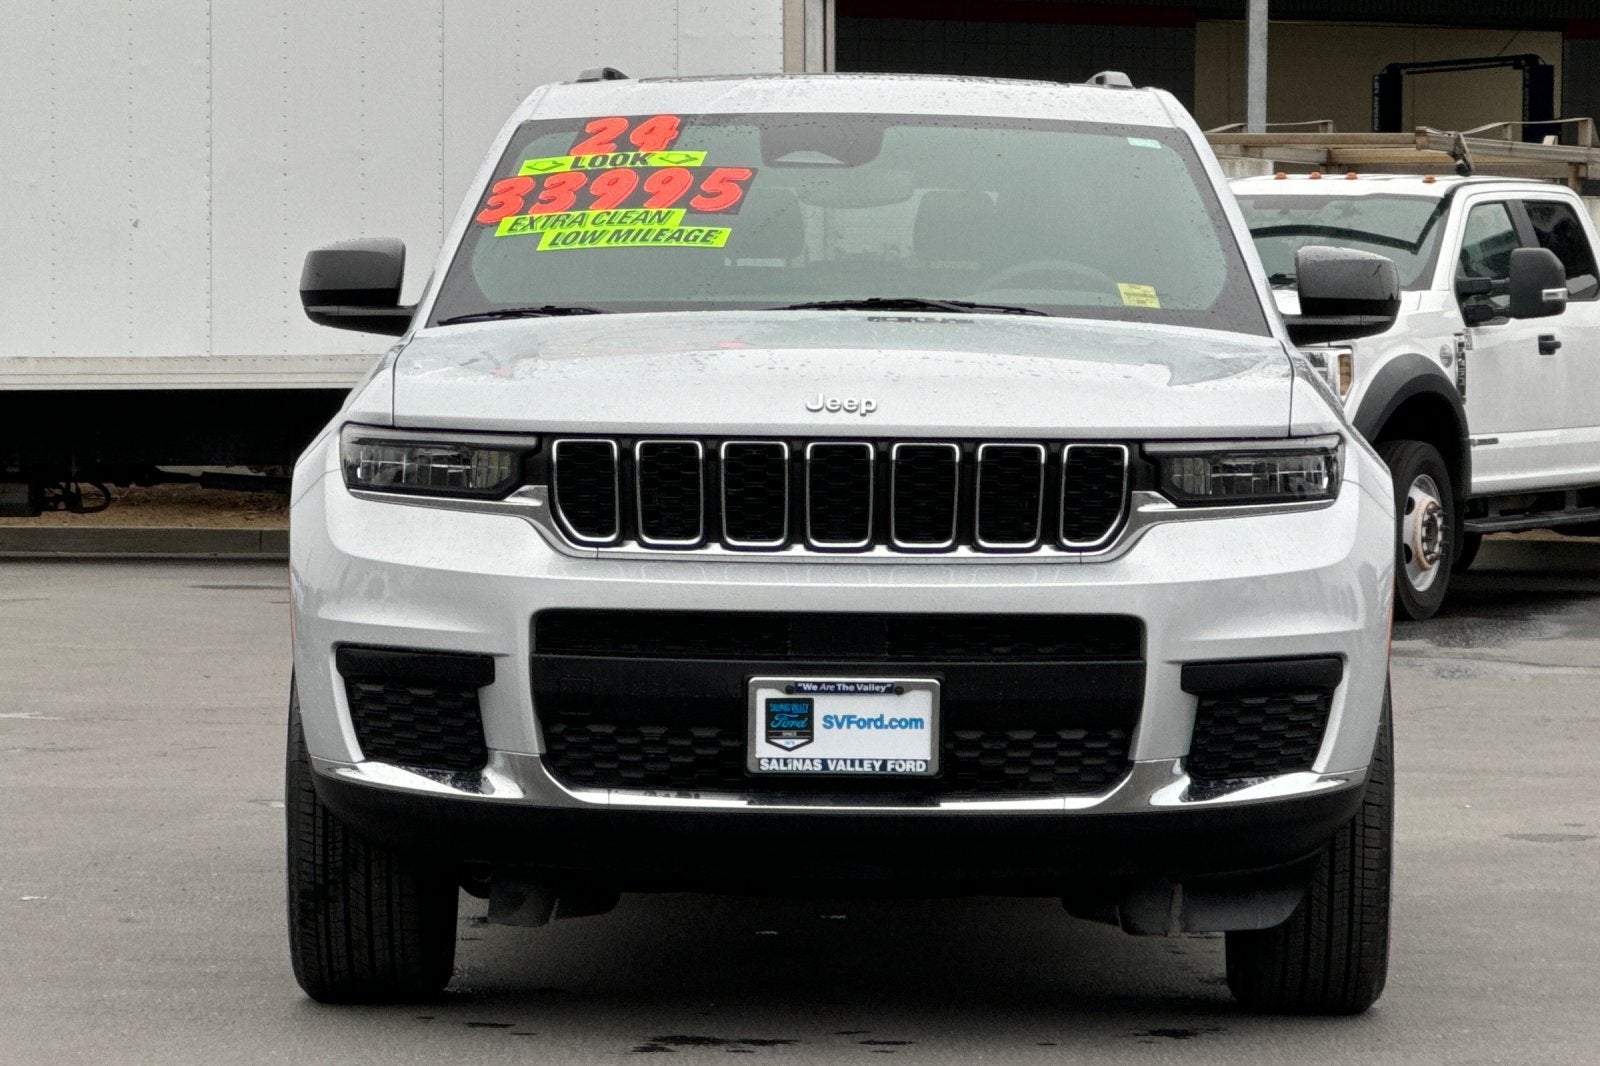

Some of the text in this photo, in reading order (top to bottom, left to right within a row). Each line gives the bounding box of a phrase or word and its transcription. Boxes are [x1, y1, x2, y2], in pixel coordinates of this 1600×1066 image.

[570, 114, 680, 155] 24
[570, 153, 654, 169] LOOK
[476, 167, 752, 223] 33995
[507, 209, 670, 233] EXTRA CLEAN
[548, 229, 719, 247] LOW MILEAGE
[806, 393, 877, 416] Jeep
[819, 683, 835, 691] Are
[836, 684, 855, 692] The
[770, 713, 808, 728] Ford
[822, 714, 924, 730] SVFord.com
[759, 758, 927, 772] SALINAS VALLEY FORD
